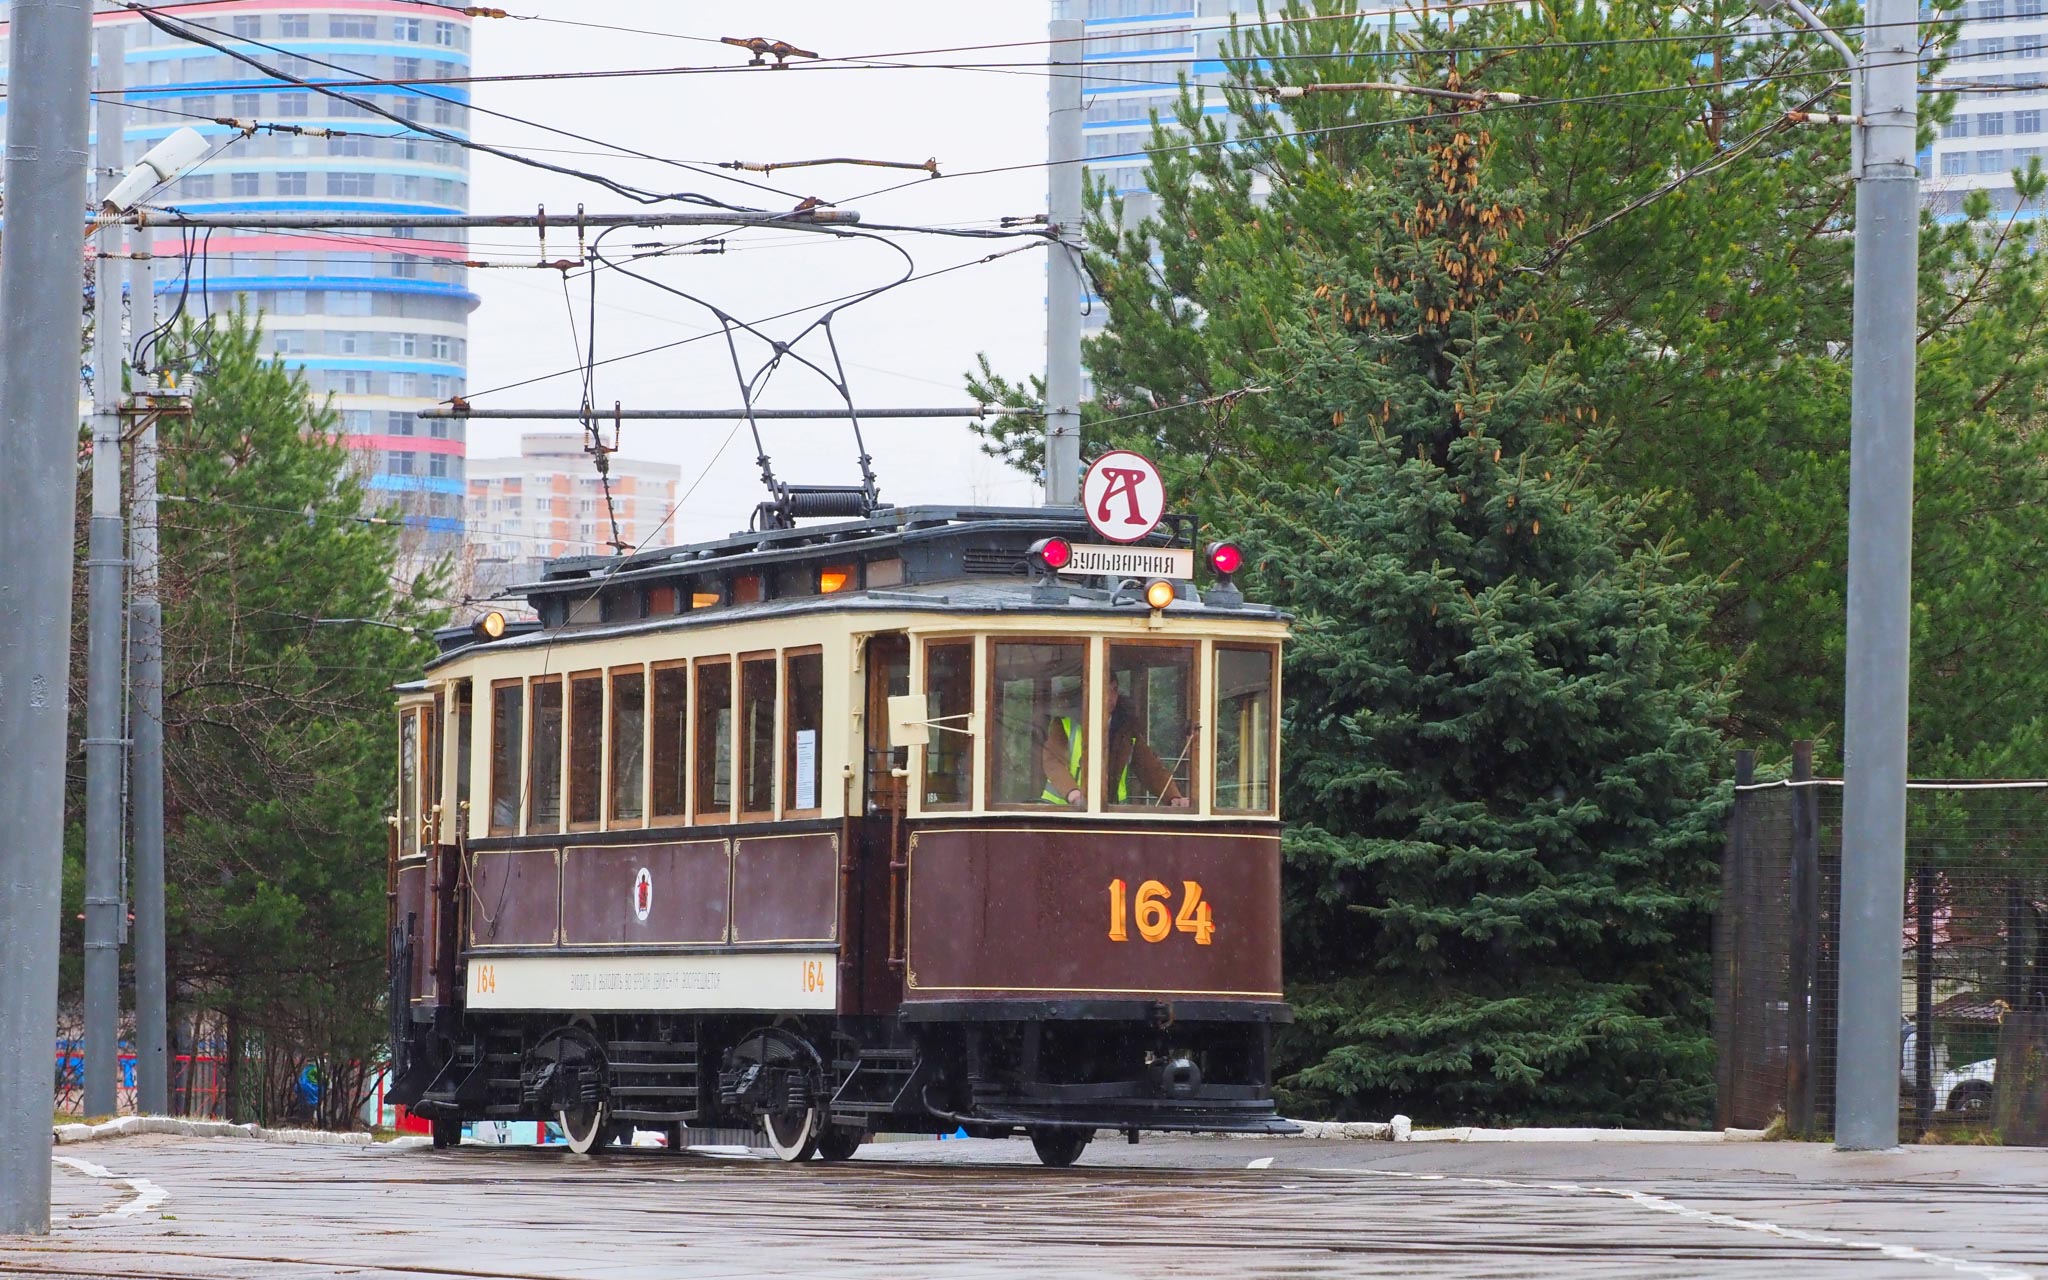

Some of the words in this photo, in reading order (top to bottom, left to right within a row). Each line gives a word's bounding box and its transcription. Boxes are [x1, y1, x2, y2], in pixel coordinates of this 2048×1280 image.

[1069, 552, 1174, 574] БУЛЬВАРНАЯ
[1108, 878, 1216, 945] 164
[477, 964, 496, 994] 164
[802, 960, 825, 993] 164
